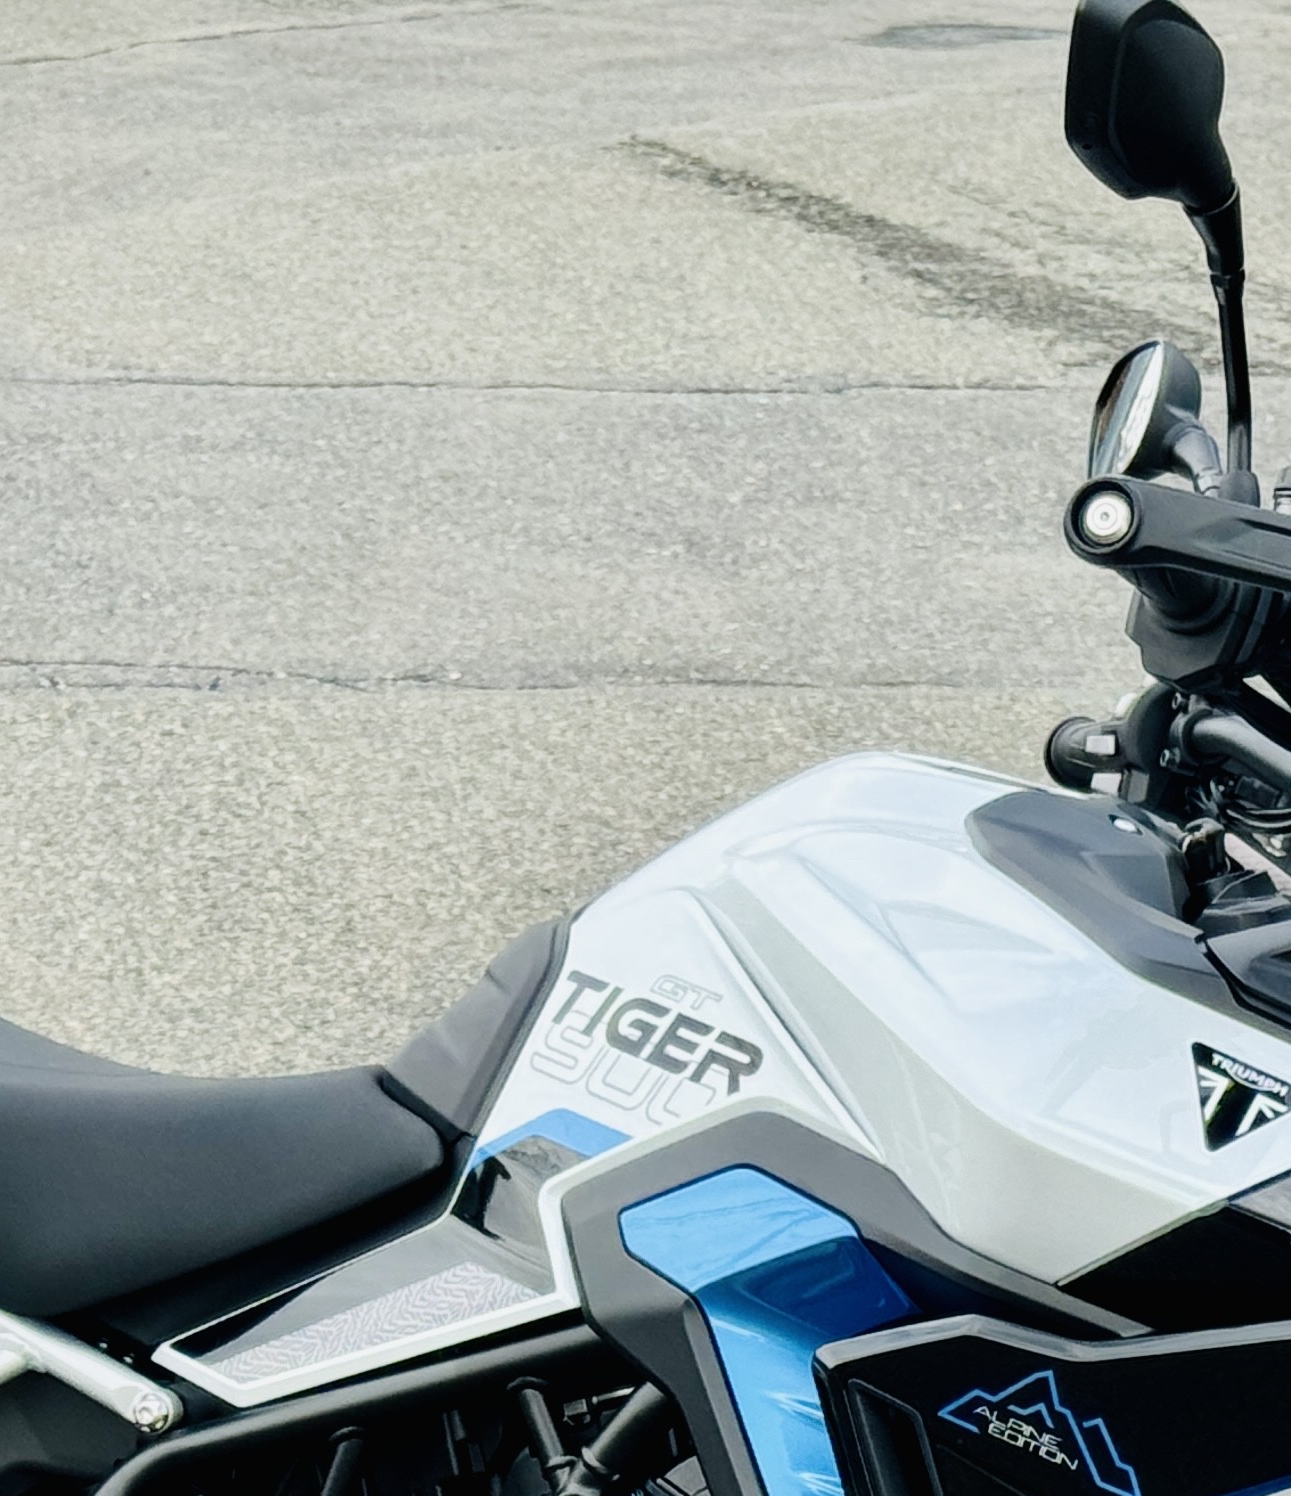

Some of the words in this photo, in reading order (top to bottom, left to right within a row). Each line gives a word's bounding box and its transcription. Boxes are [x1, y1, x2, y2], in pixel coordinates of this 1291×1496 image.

[650, 974, 724, 1012] GT
[551, 970, 764, 1097] TIGER
[1211, 1052, 1290, 1098] TRIUMPH
[973, 1405, 1063, 1451] ALPINE
[988, 1422, 1079, 1471] EDITION
